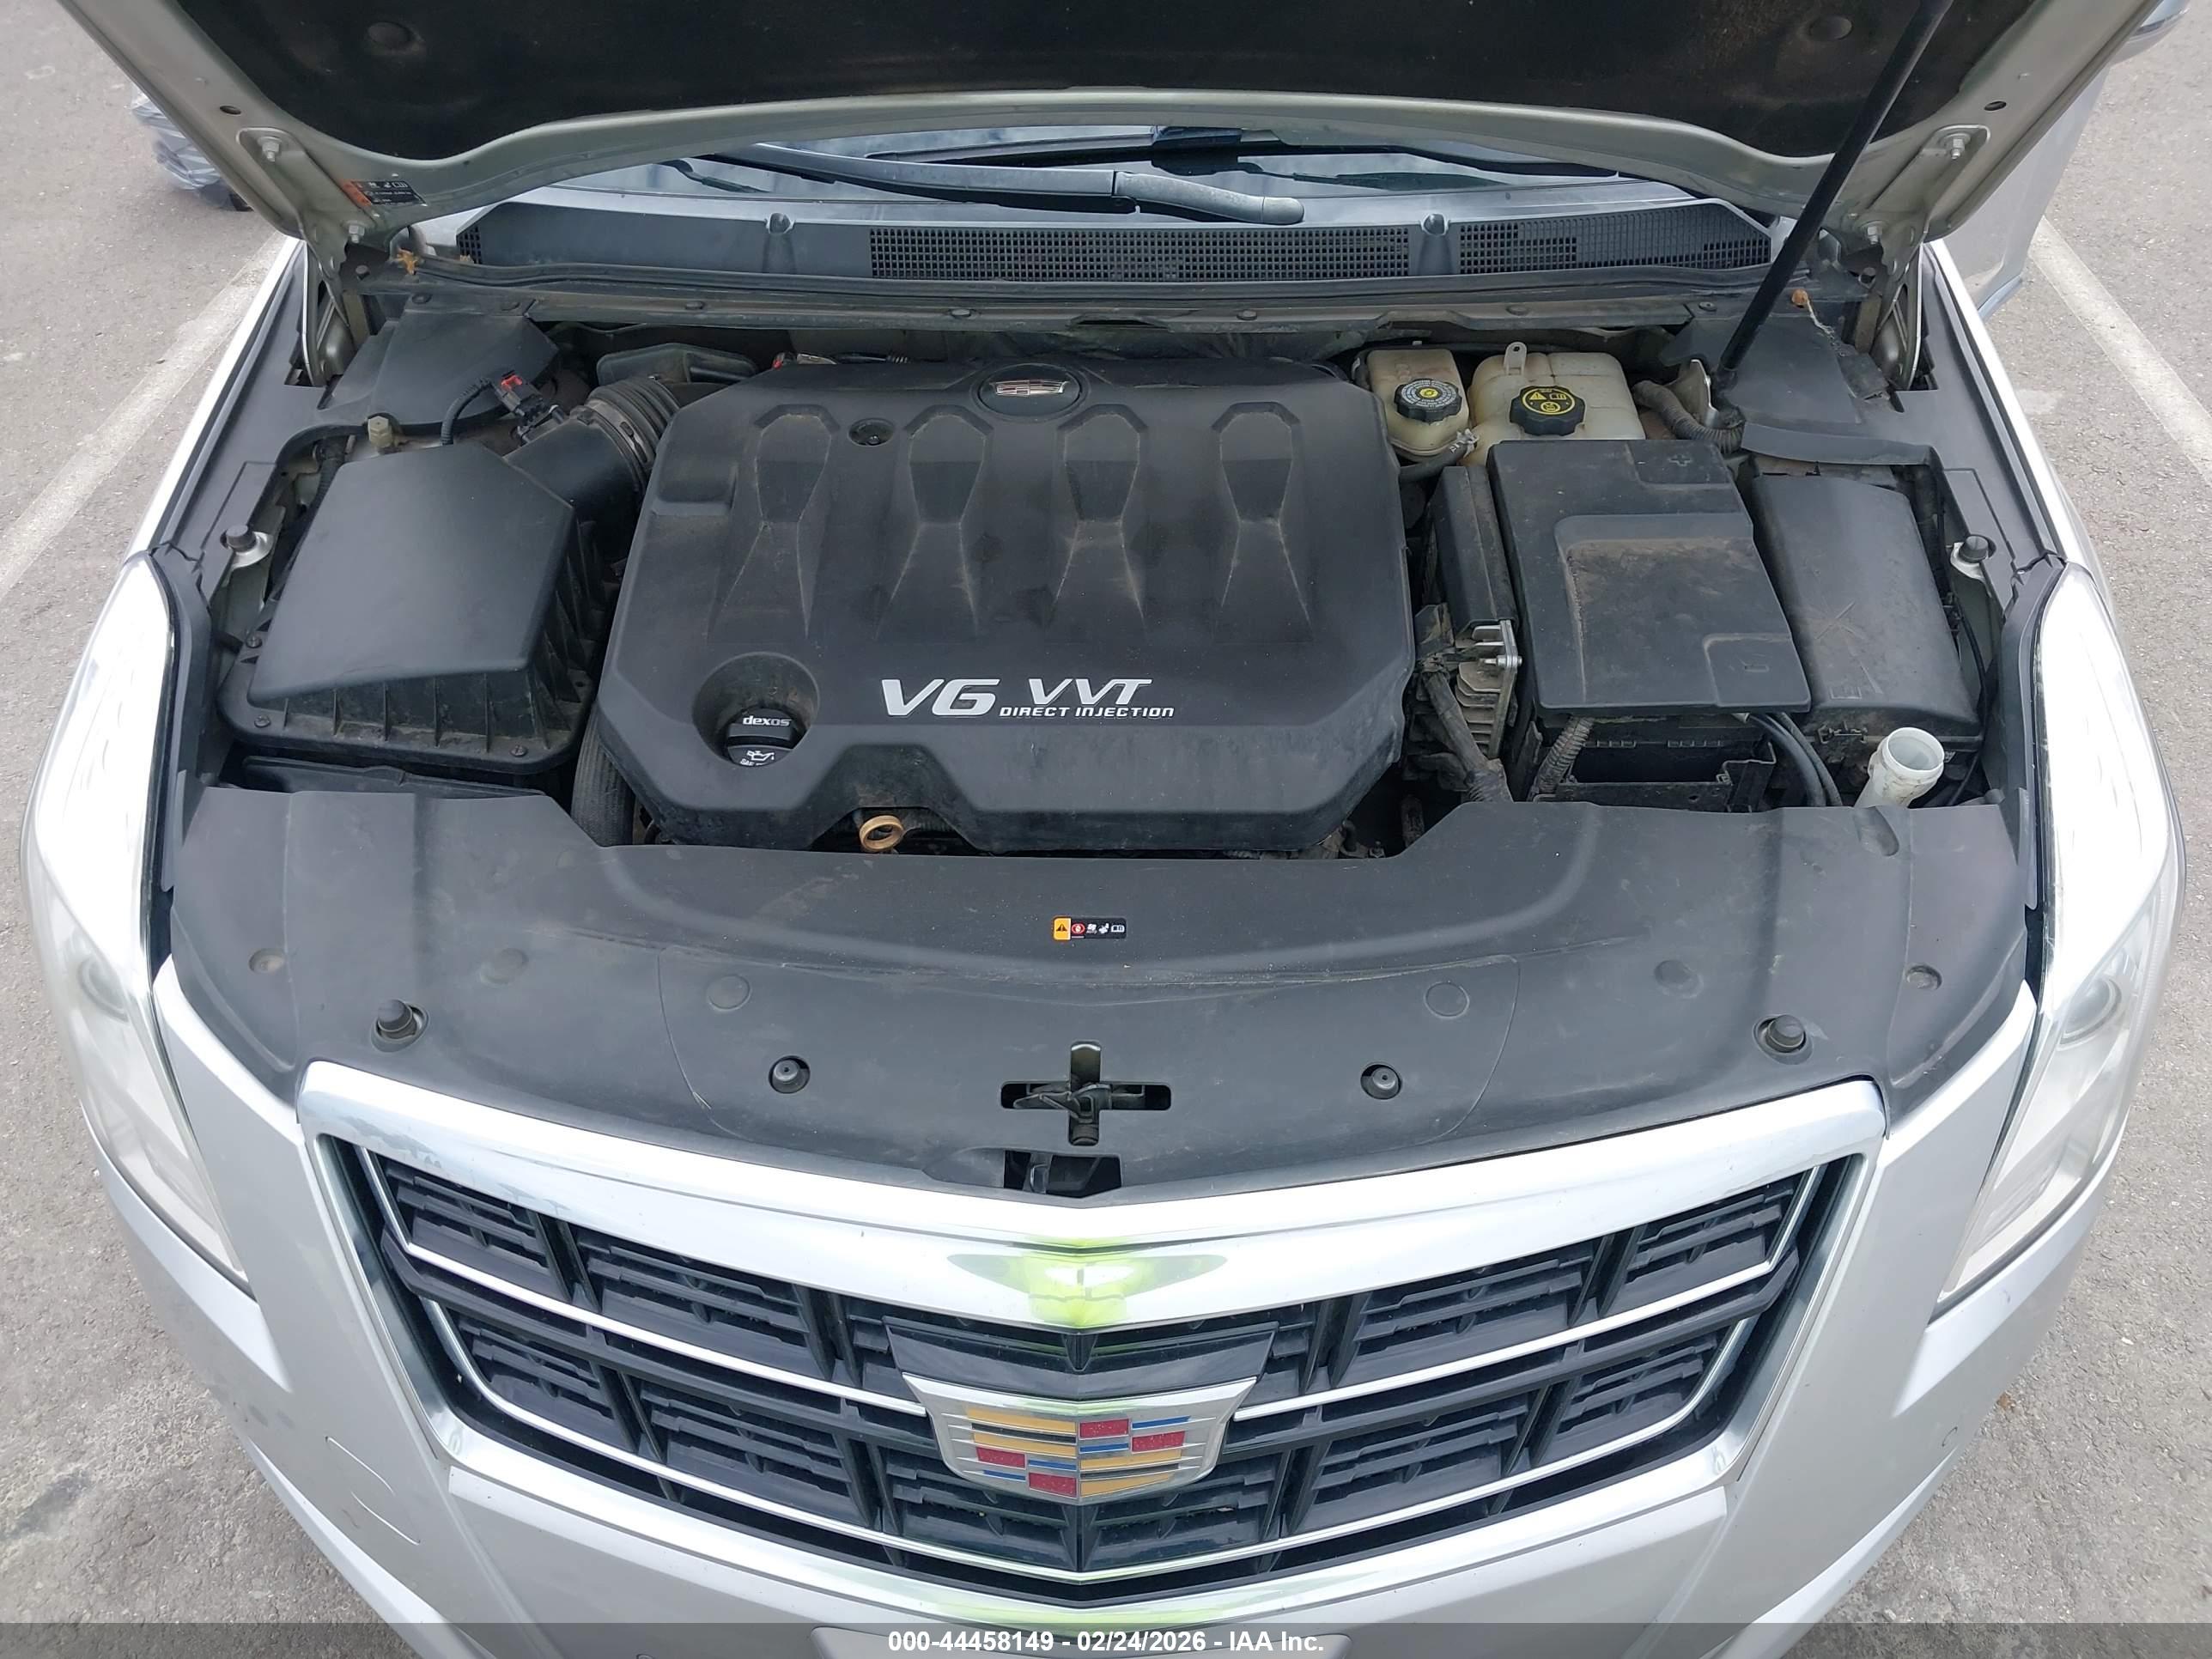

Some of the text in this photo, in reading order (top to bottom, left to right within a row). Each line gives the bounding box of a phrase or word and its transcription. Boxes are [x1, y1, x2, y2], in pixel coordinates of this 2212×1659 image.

[881, 678, 1152, 716] V6 VVT
[999, 707, 1175, 719] DIRECT INJECTION
[742, 715, 792, 726] dexos
